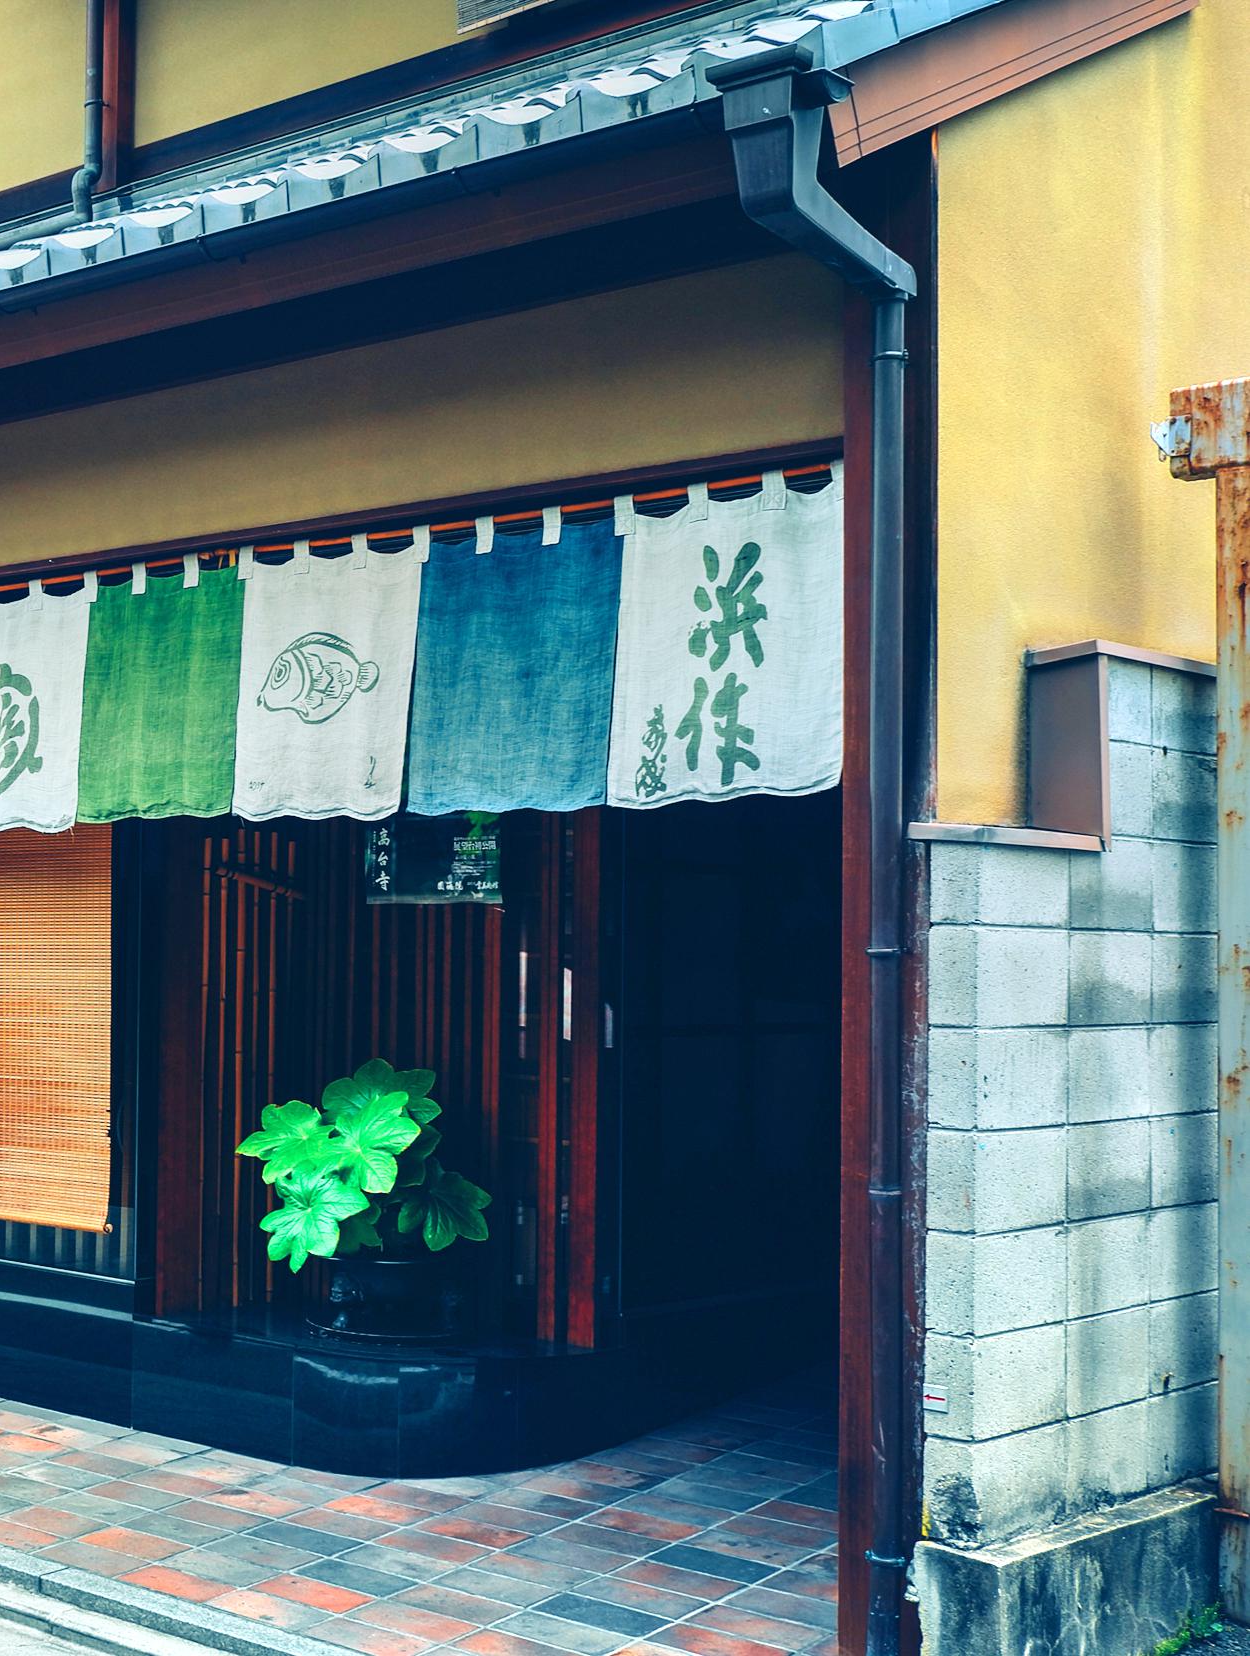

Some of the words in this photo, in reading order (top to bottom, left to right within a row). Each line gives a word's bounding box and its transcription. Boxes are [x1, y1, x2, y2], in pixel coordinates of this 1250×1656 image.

[674, 541, 768, 787] 浜作
[375, 827, 391, 891] 高台寺
